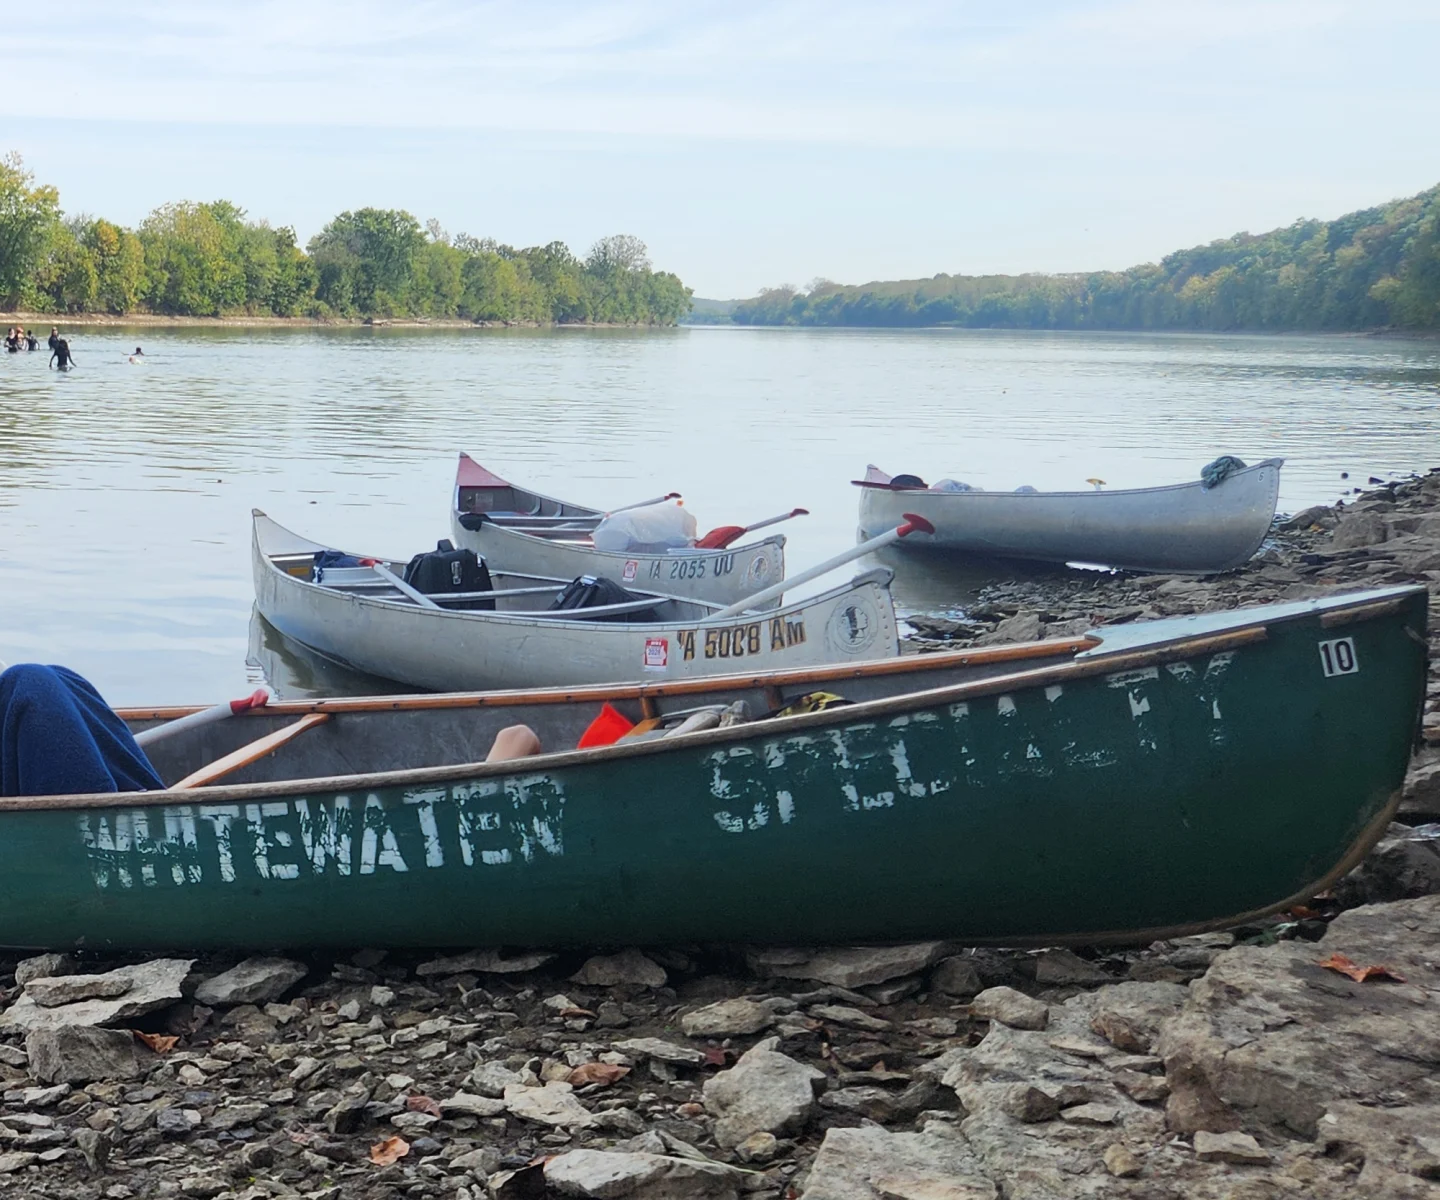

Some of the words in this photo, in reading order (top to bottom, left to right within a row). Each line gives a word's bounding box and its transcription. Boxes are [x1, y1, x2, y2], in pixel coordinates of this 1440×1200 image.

[670, 559, 707, 579] 2055
[714, 554, 734, 577] UU
[1321, 640, 1354, 675] 10
[78, 776, 566, 889] WHITEWATER
